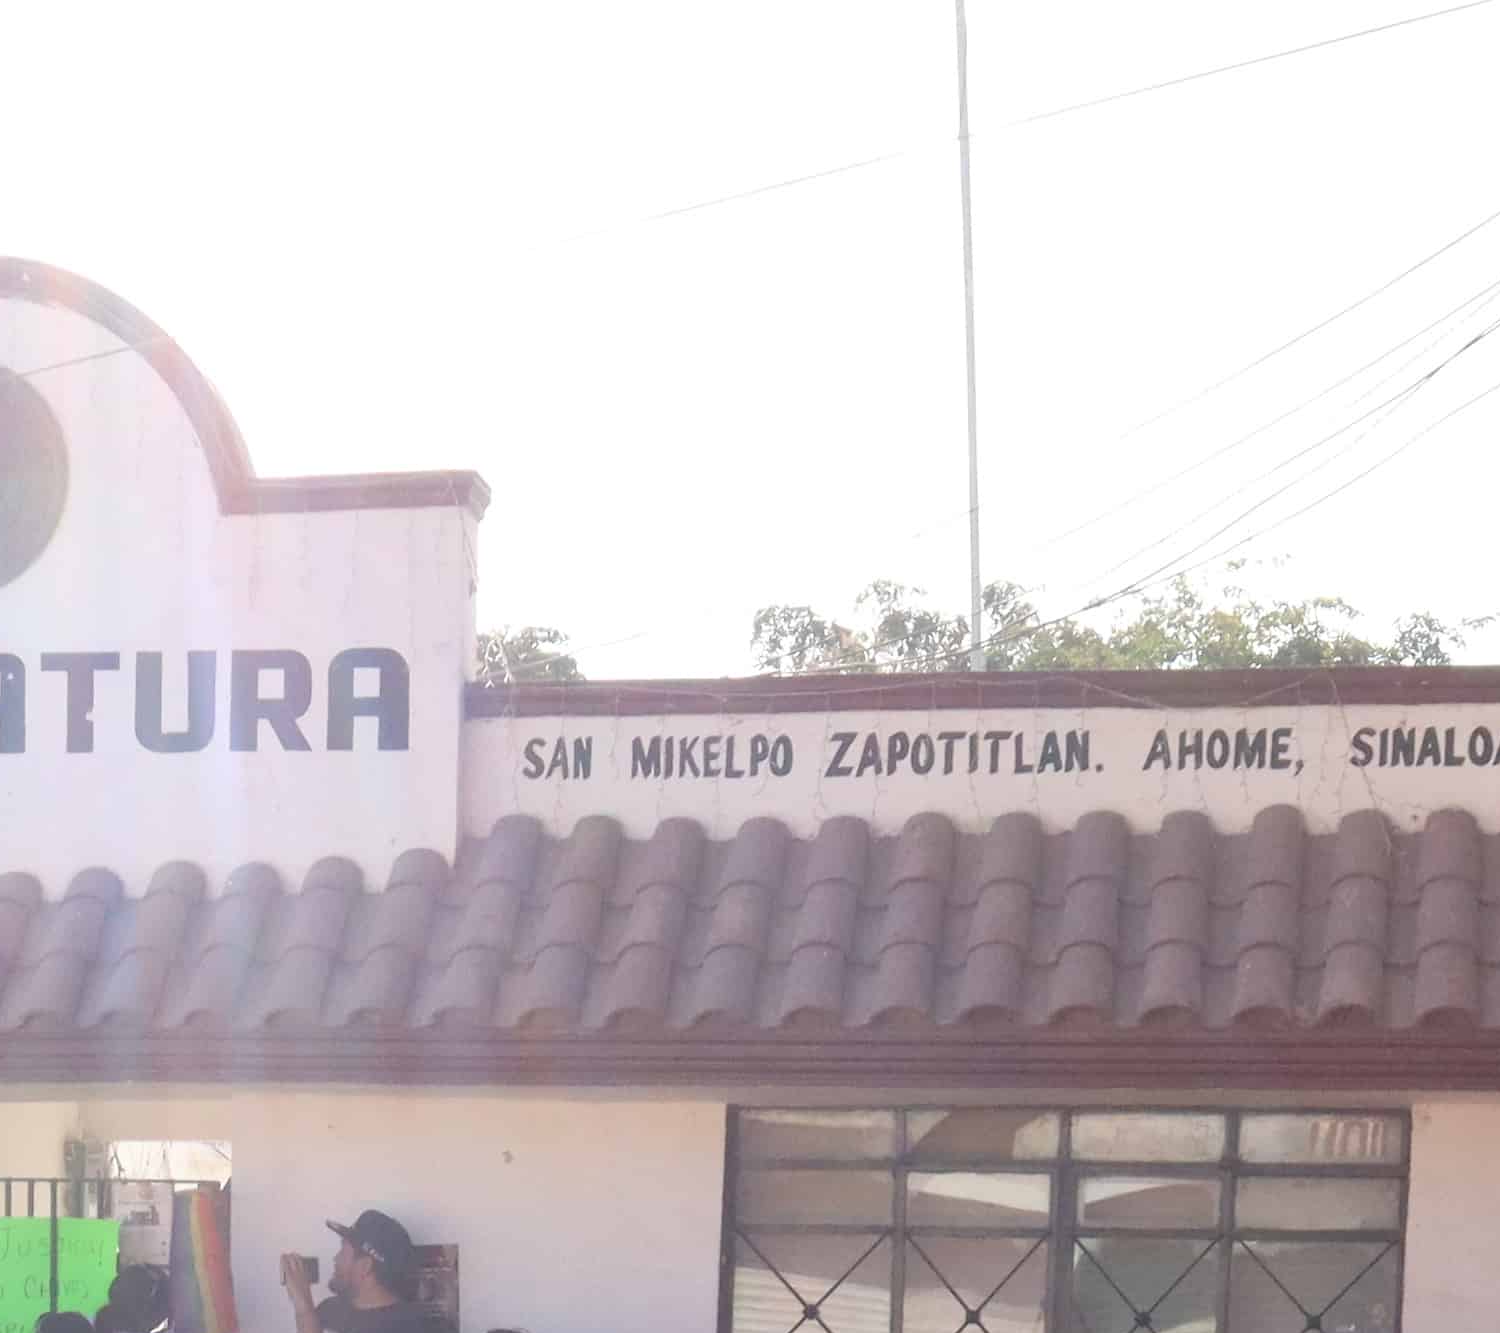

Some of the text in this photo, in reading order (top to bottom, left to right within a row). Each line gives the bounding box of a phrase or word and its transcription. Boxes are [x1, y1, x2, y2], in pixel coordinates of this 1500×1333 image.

[522, 736, 593, 780] SAN
[631, 733, 794, 780] MIKELPO
[823, 730, 1105, 778] ZAPOTITLAN.
[1141, 727, 1305, 777] AHOME,
